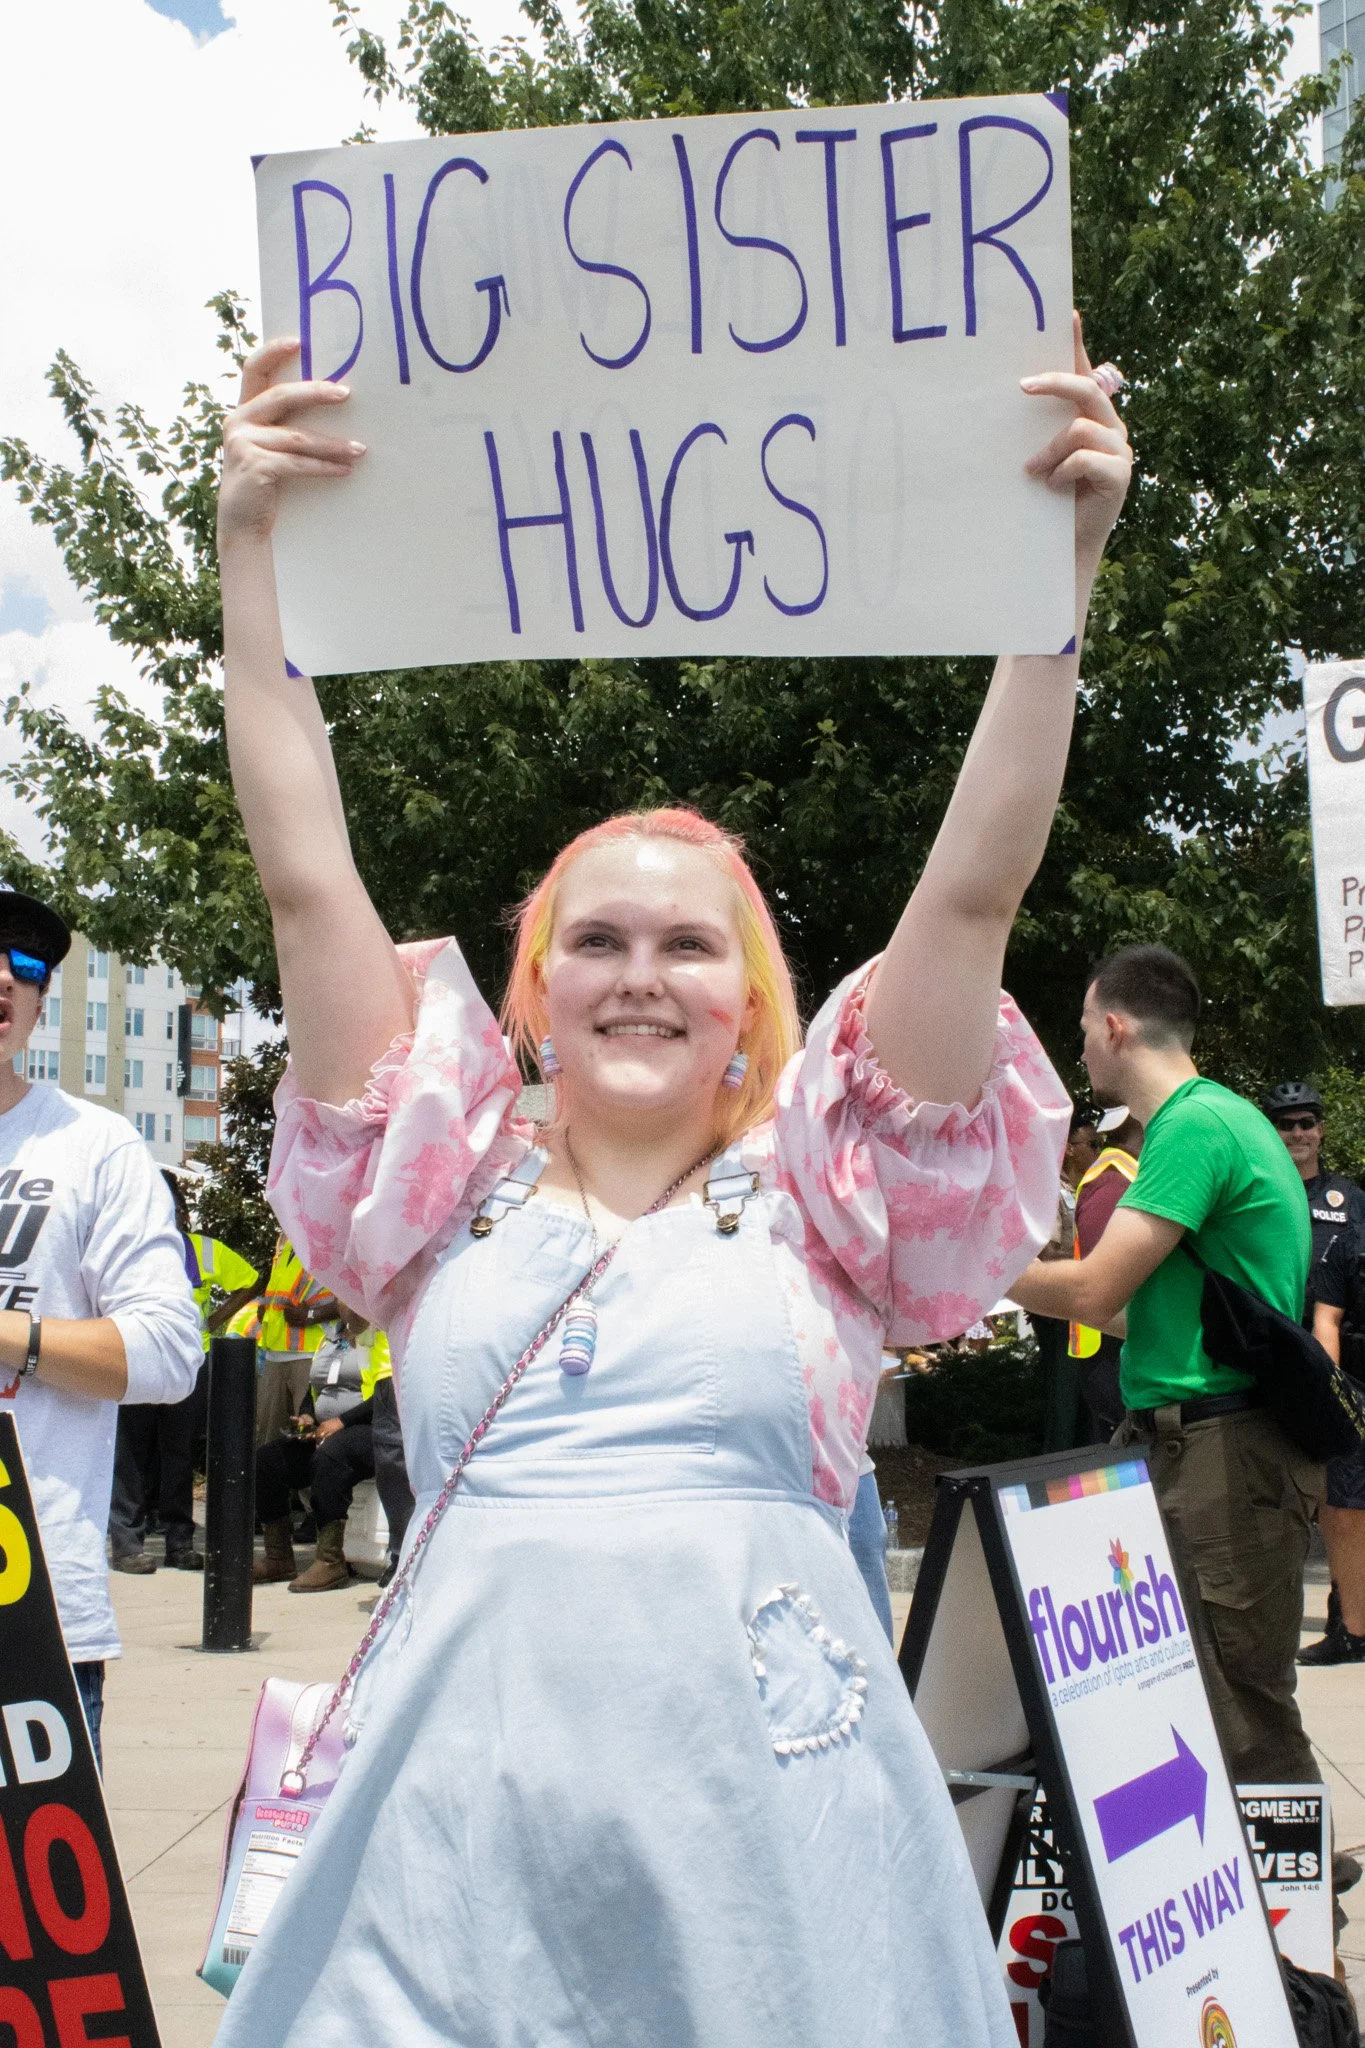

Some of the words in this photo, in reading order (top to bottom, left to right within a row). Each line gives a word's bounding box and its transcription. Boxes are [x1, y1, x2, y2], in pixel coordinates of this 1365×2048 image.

[292, 156, 511, 384] BIG
[563, 115, 1055, 369] SISTER
[483, 413, 830, 634] HUGS
[1312, 1208, 1347, 1223] POLICE
[1028, 1555, 1186, 1685] flourish
[1052, 1692, 1059, 1707] a
[1060, 1675, 1105, 1704] celebration
[1104, 1665, 1112, 1686] of
[1112, 1660, 1135, 1686] lgbtq
[1136, 1656, 1149, 1674] arts
[1150, 1647, 1164, 1667] and
[1165, 1638, 1191, 1660] culture
[0, 1700, 73, 1786] D
[282, 1837, 303, 1846] Facts
[1273, 1816, 1304, 1824] Hebrews
[1304, 1816, 1320, 1824] 9:27
[1118, 1898, 1186, 1984] THIS
[1182, 1856, 1245, 1939] WAY
[1280, 1884, 1300, 1892] John
[1302, 1883, 1320, 1891] 14:6
[1186, 1971, 1212, 1998] Presented
[1211, 1967, 1220, 1982] by
